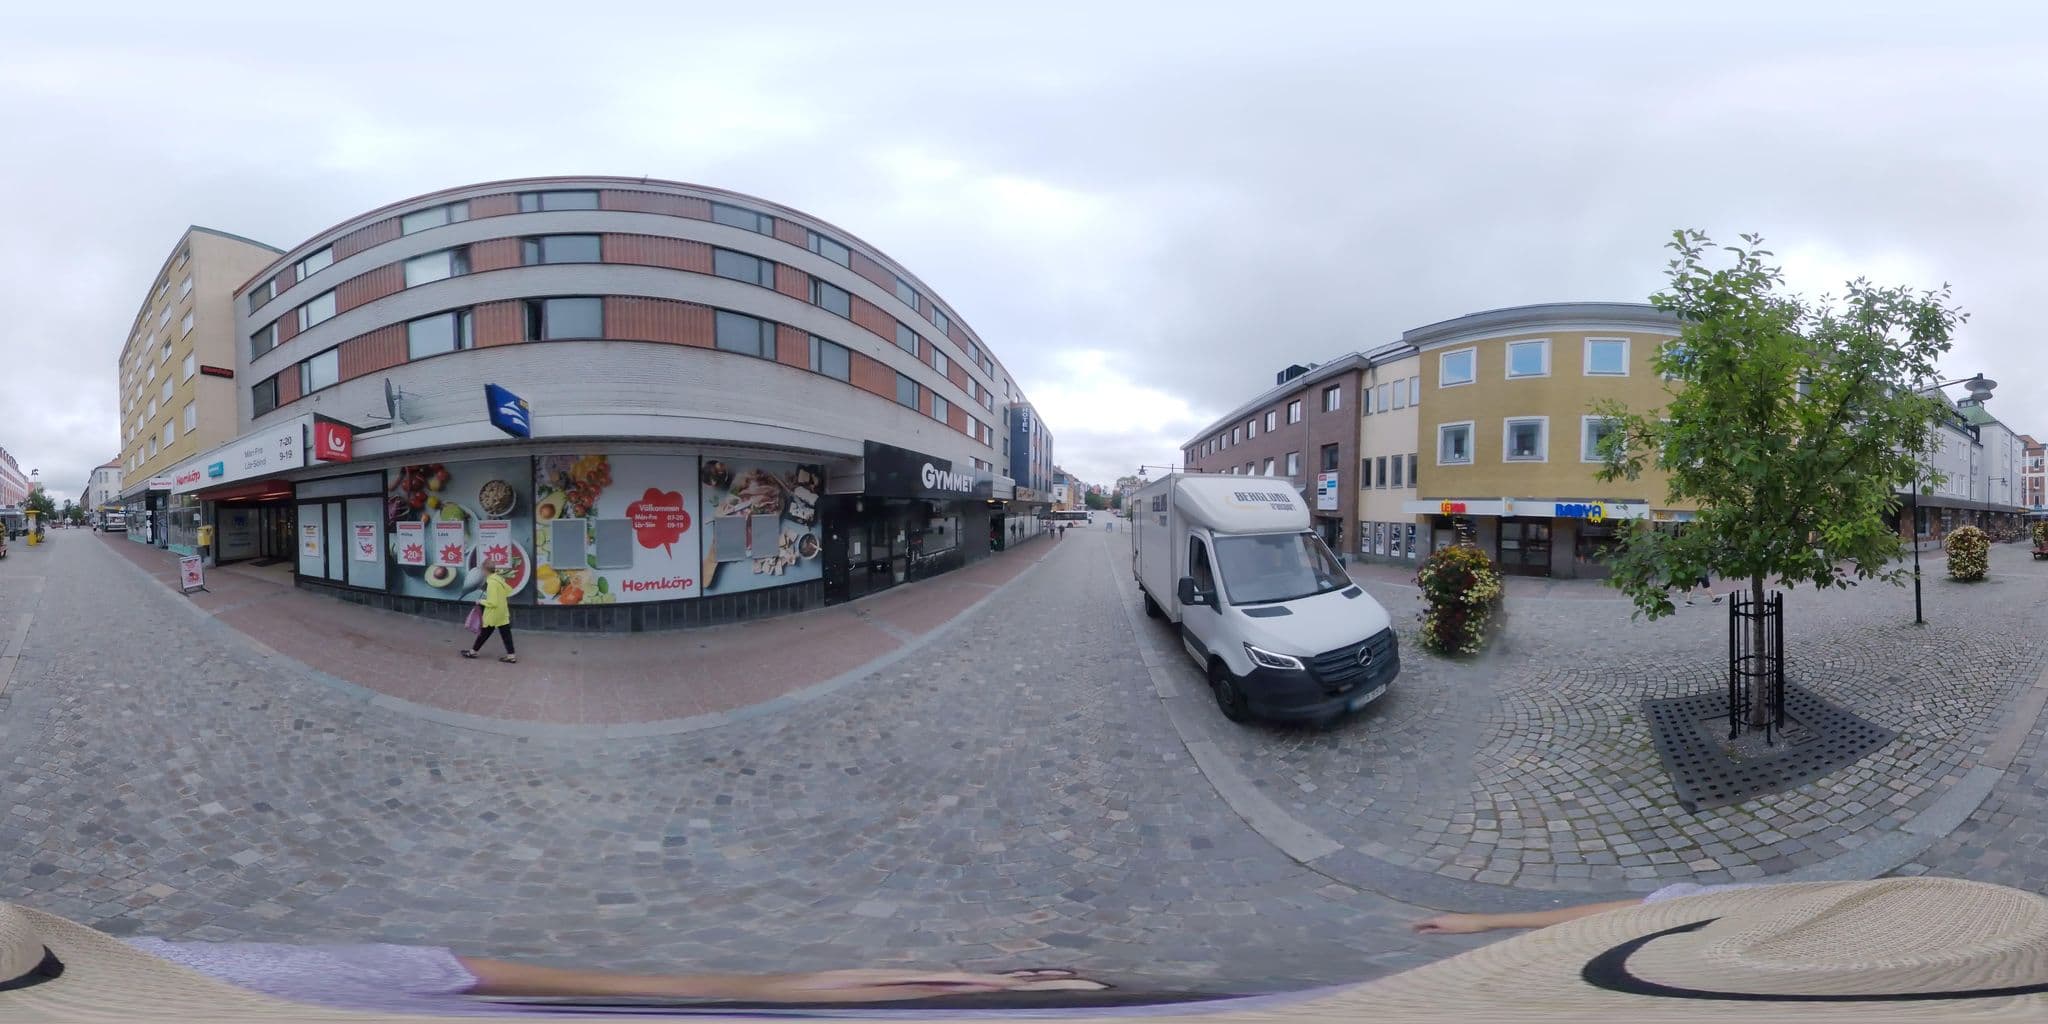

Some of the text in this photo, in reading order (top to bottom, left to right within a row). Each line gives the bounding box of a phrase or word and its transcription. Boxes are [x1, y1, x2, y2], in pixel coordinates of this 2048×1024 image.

[279, 437, 292, 447] 7-20
[279, 450, 293, 461] 9-19
[176, 469, 201, 487] Hemköp
[922, 462, 974, 492] GYMMET
[640, 504, 680, 512] Välkommen
[622, 576, 693, 592] Hemköp
